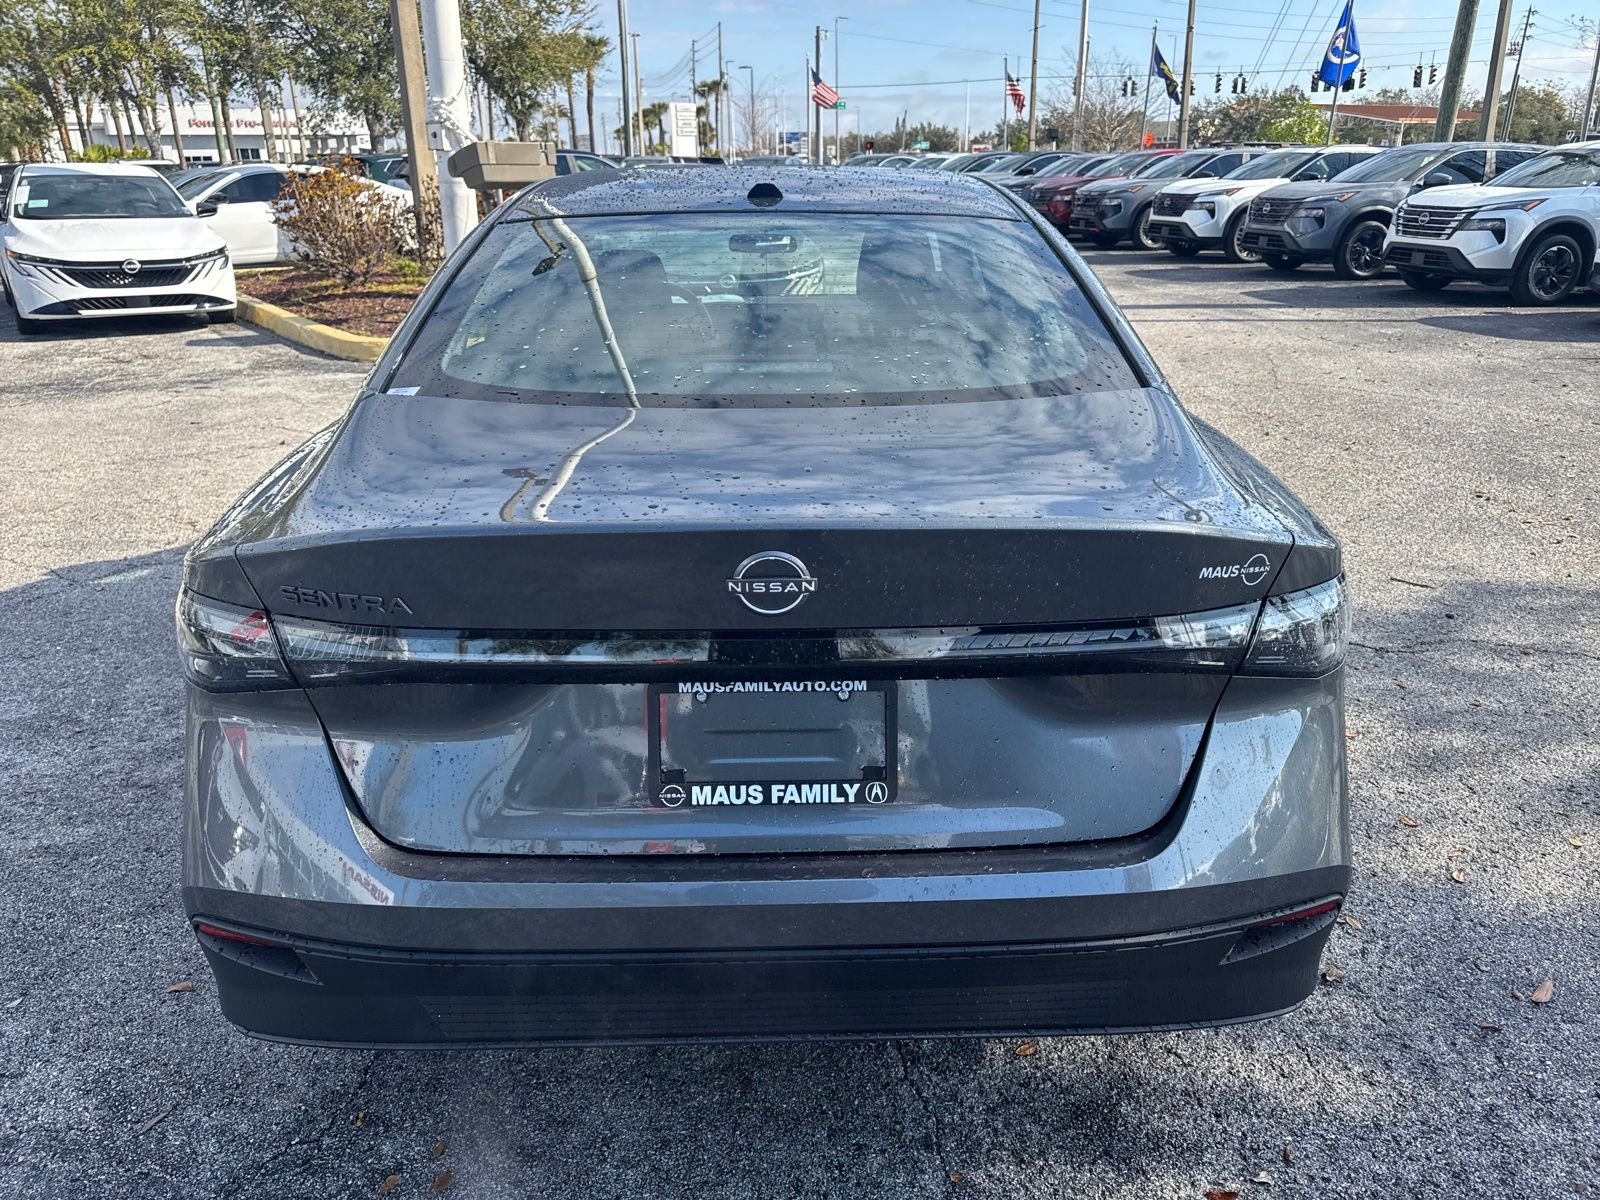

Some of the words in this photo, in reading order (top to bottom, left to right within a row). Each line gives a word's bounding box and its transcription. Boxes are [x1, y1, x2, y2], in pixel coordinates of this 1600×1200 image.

[1199, 565, 1240, 579] MAUS
[1240, 566, 1271, 574] NISSAN
[728, 581, 815, 593] NISSAN
[280, 585, 414, 615] SENTRA
[678, 680, 868, 693] MAUSFAMILYAUTO.COM
[691, 785, 764, 805] MAUS
[771, 783, 861, 804] FAMILY
